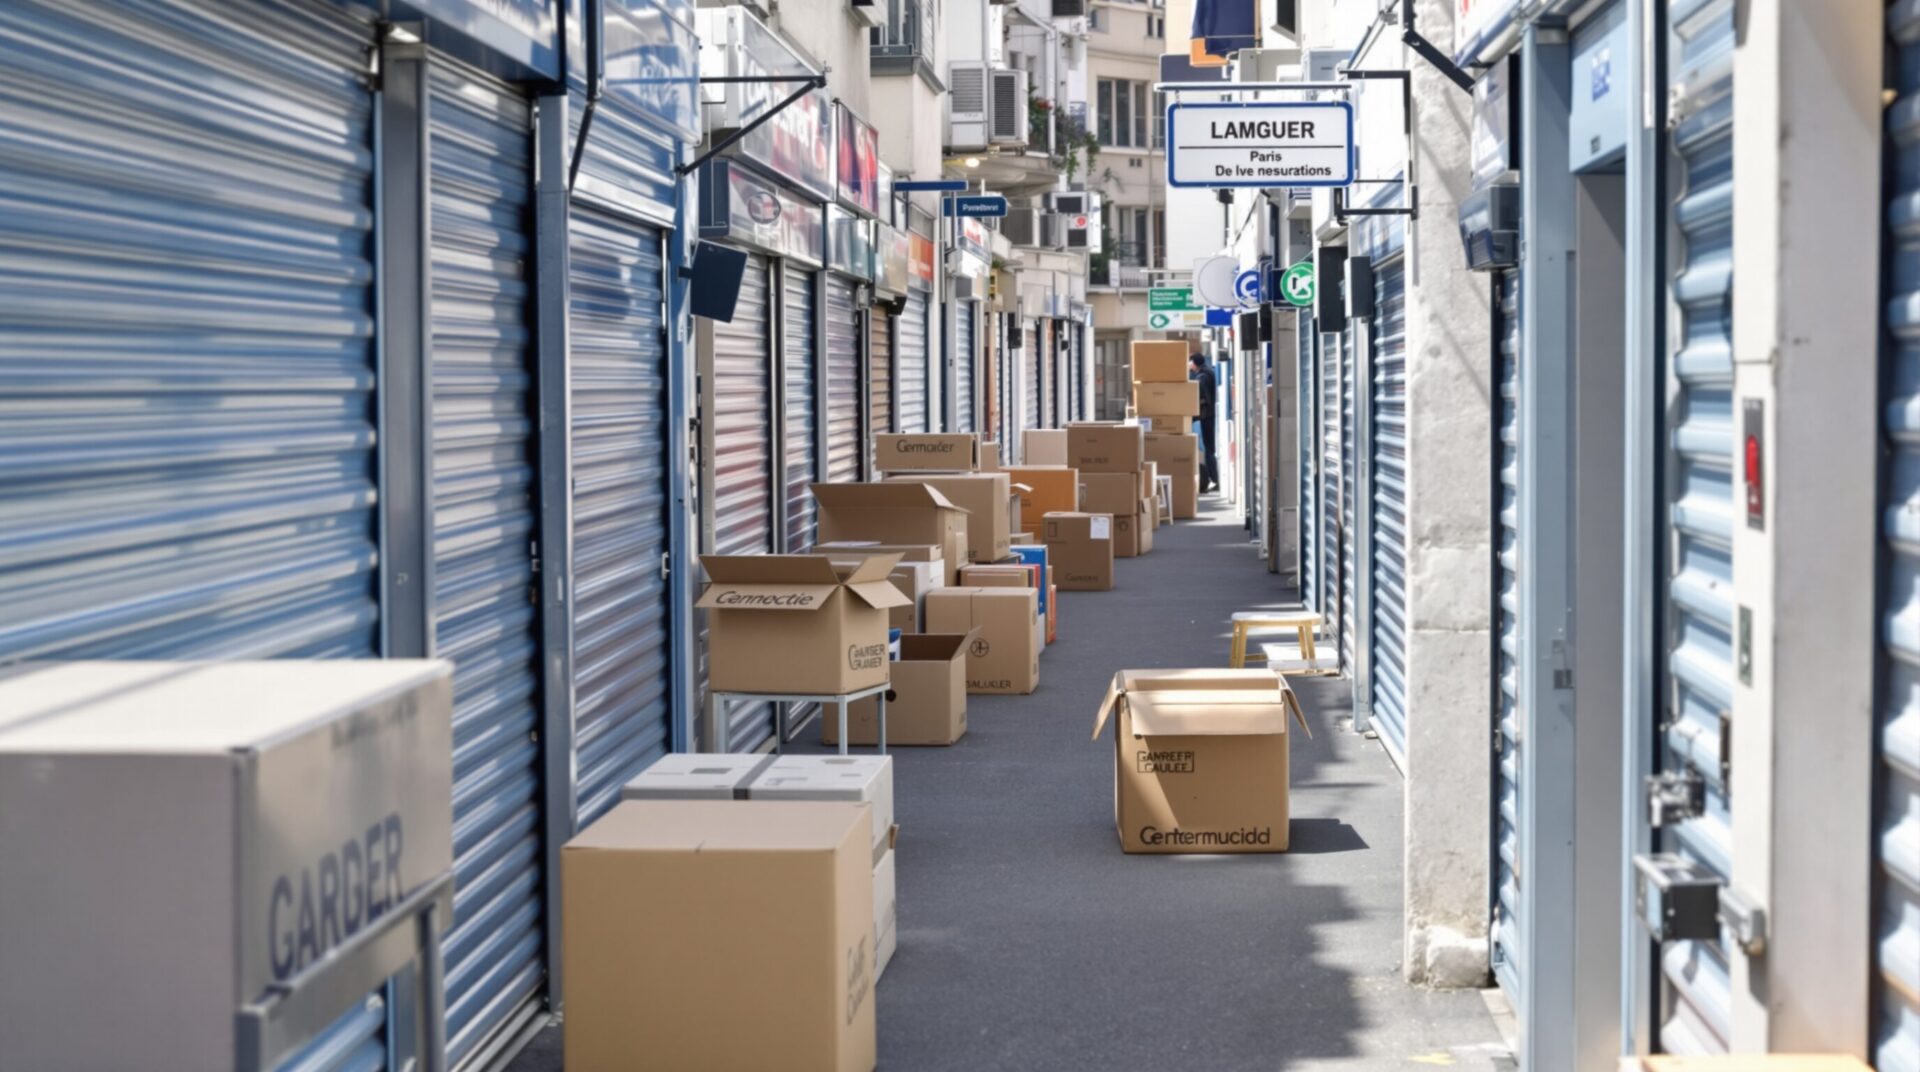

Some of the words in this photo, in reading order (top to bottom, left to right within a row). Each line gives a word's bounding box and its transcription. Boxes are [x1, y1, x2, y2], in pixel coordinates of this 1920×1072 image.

[1210, 121, 1315, 139] LAMGUER
[1250, 151, 1282, 162] Paris
[1215, 165, 1233, 177] De
[1257, 165, 1332, 177] nesurations
